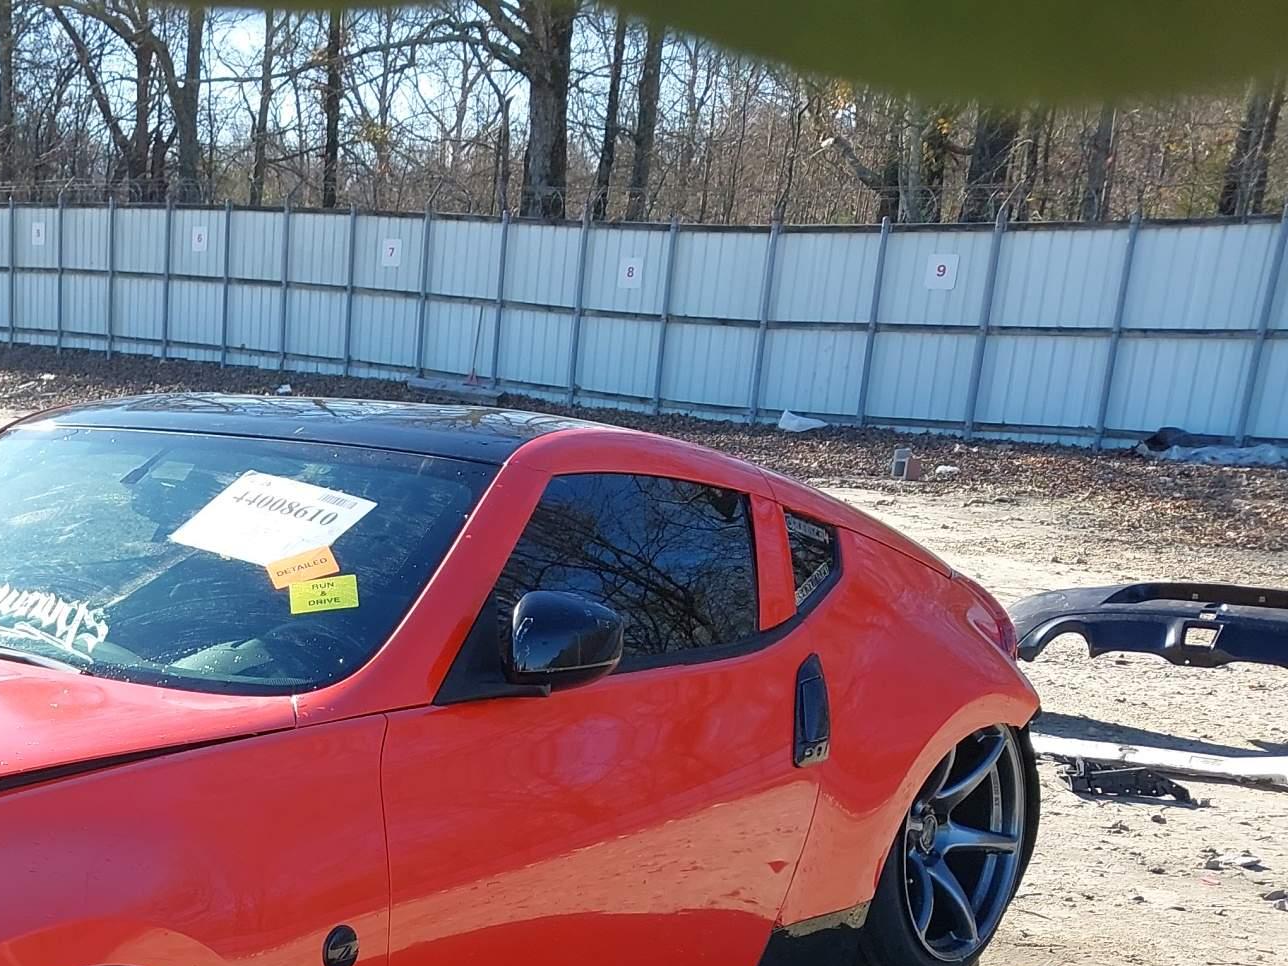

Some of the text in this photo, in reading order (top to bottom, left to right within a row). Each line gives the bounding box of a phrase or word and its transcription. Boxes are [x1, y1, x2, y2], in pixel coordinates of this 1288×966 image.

[626, 266, 635, 278] 8
[936, 264, 947, 277] 9
[276, 556, 328, 577] DETAILED
[311, 580, 335, 590] RUN
[308, 596, 341, 607] DRIVE
